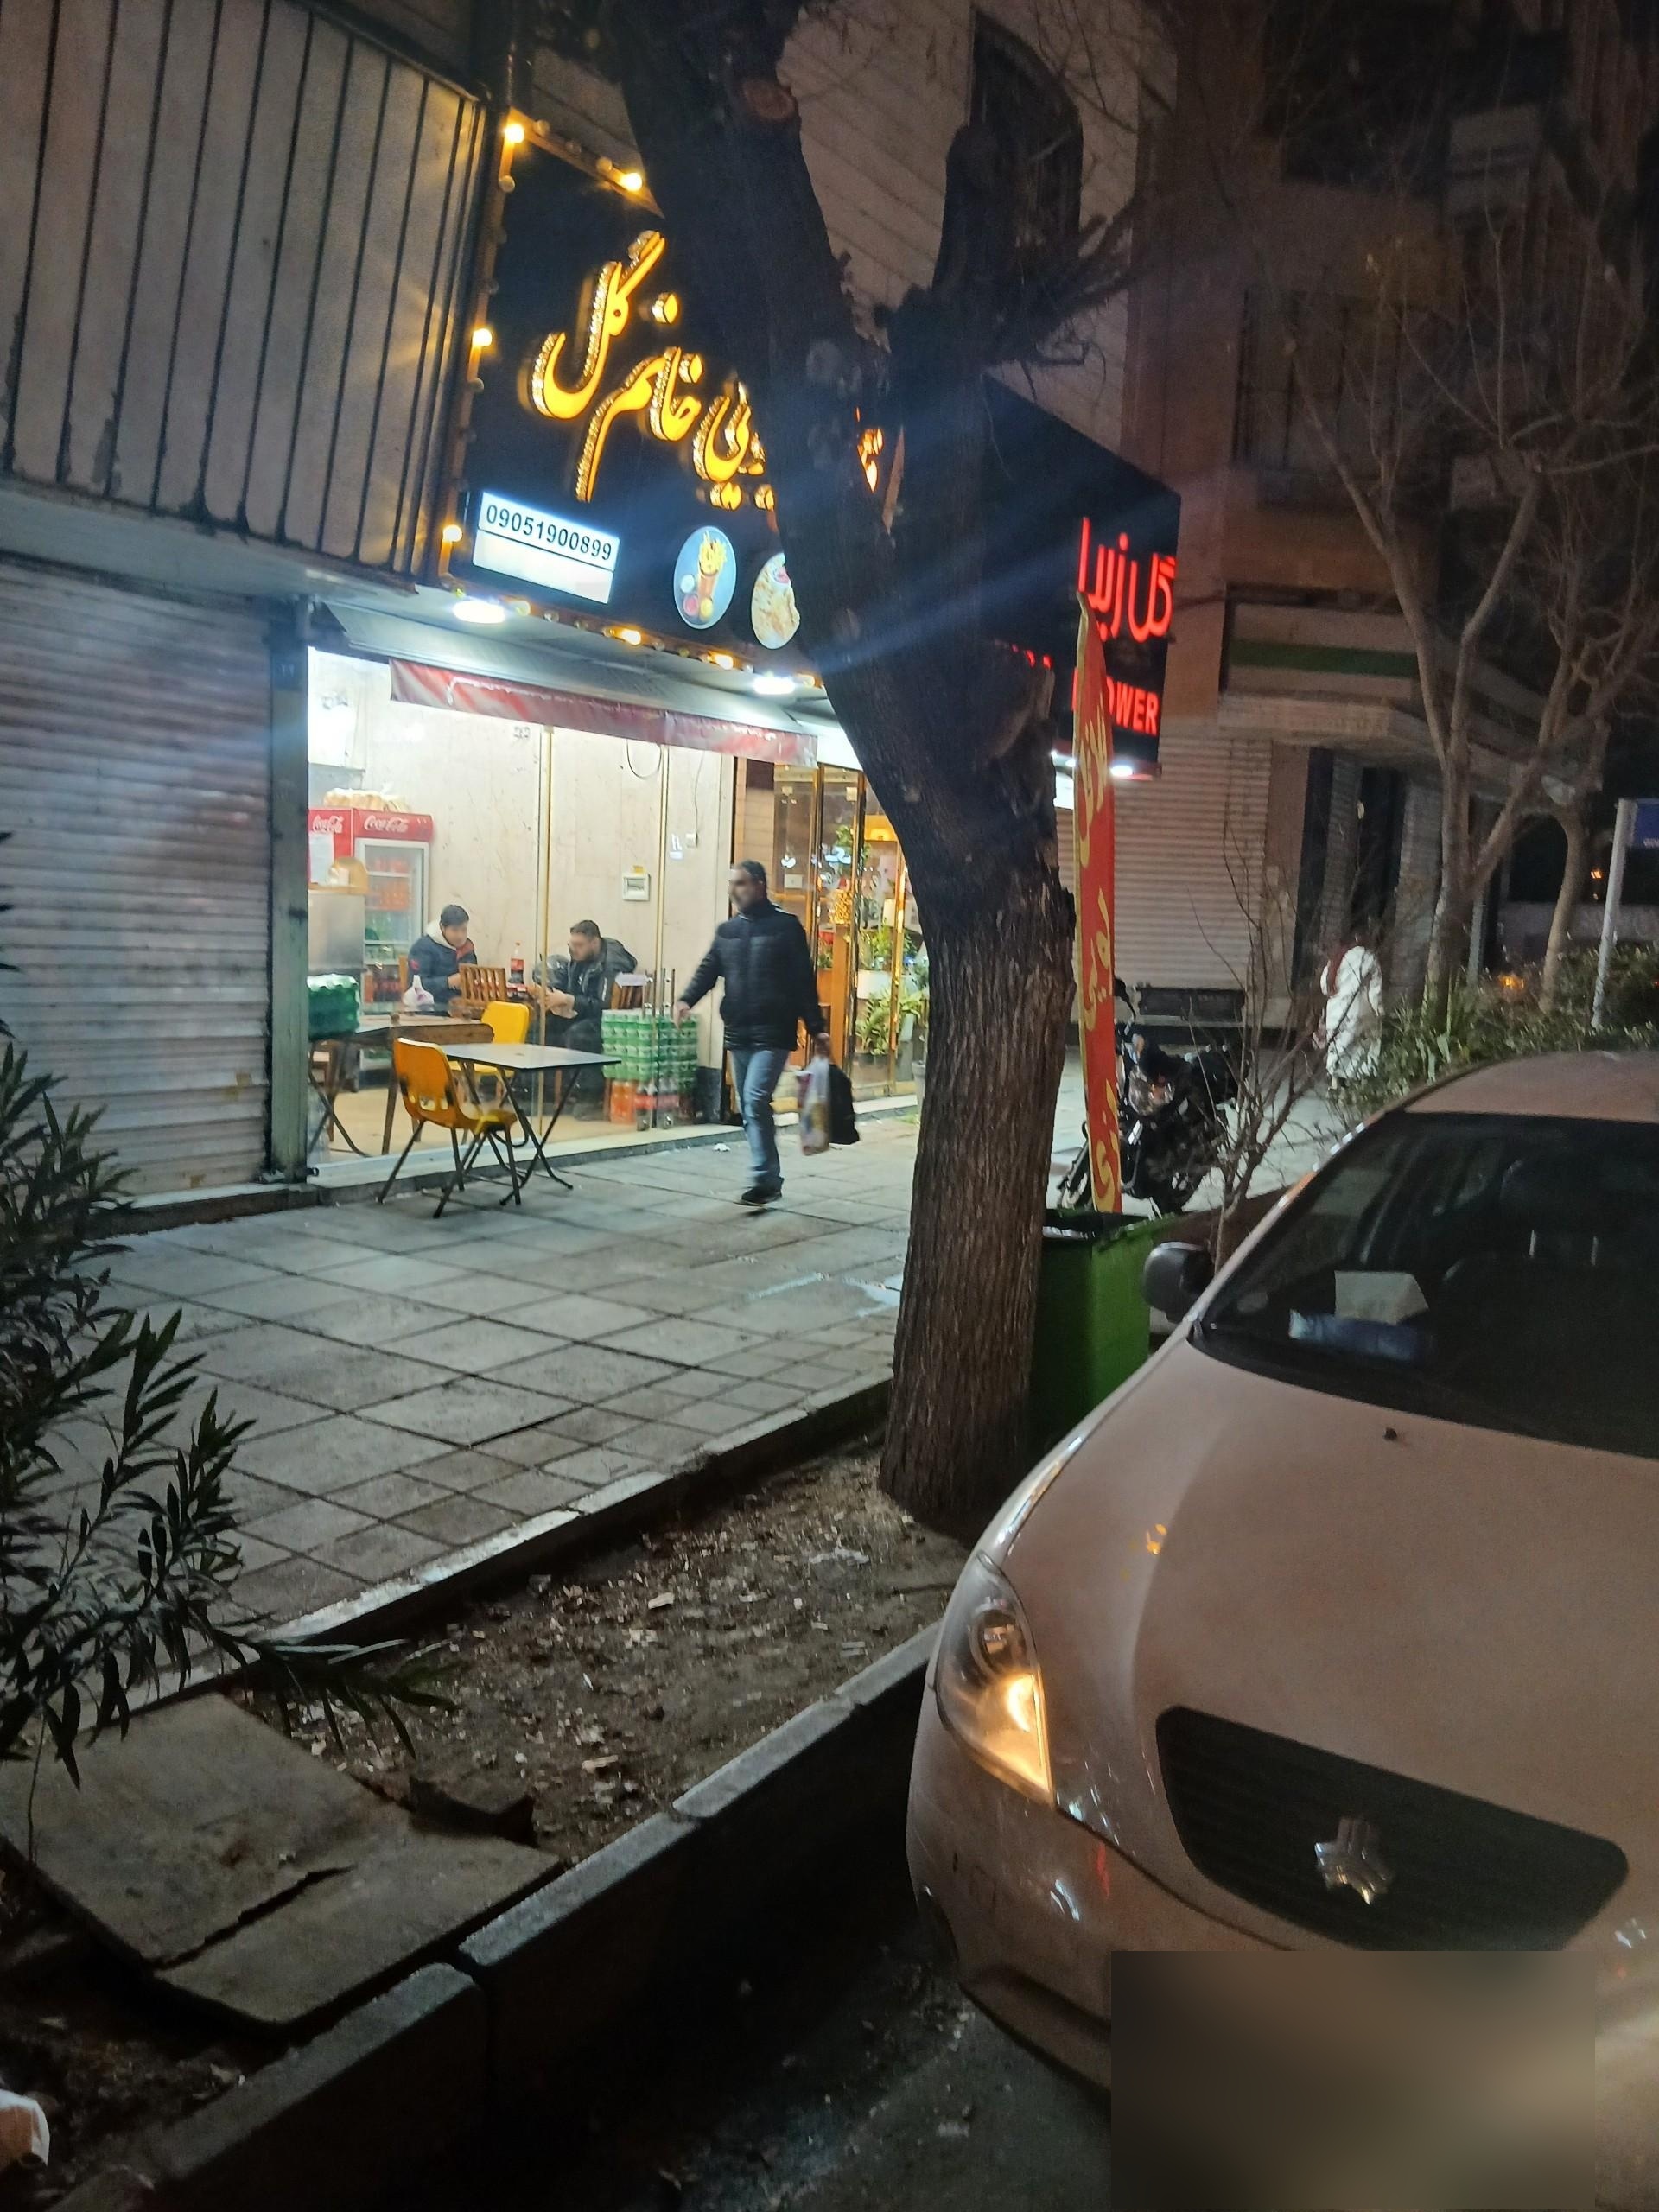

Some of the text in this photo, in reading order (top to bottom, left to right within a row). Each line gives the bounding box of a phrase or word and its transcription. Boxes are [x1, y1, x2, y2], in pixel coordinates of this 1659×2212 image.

[531, 229, 665, 420] گل
[486, 504, 613, 562] 09051900899
[1128, 551, 1177, 643] گل
